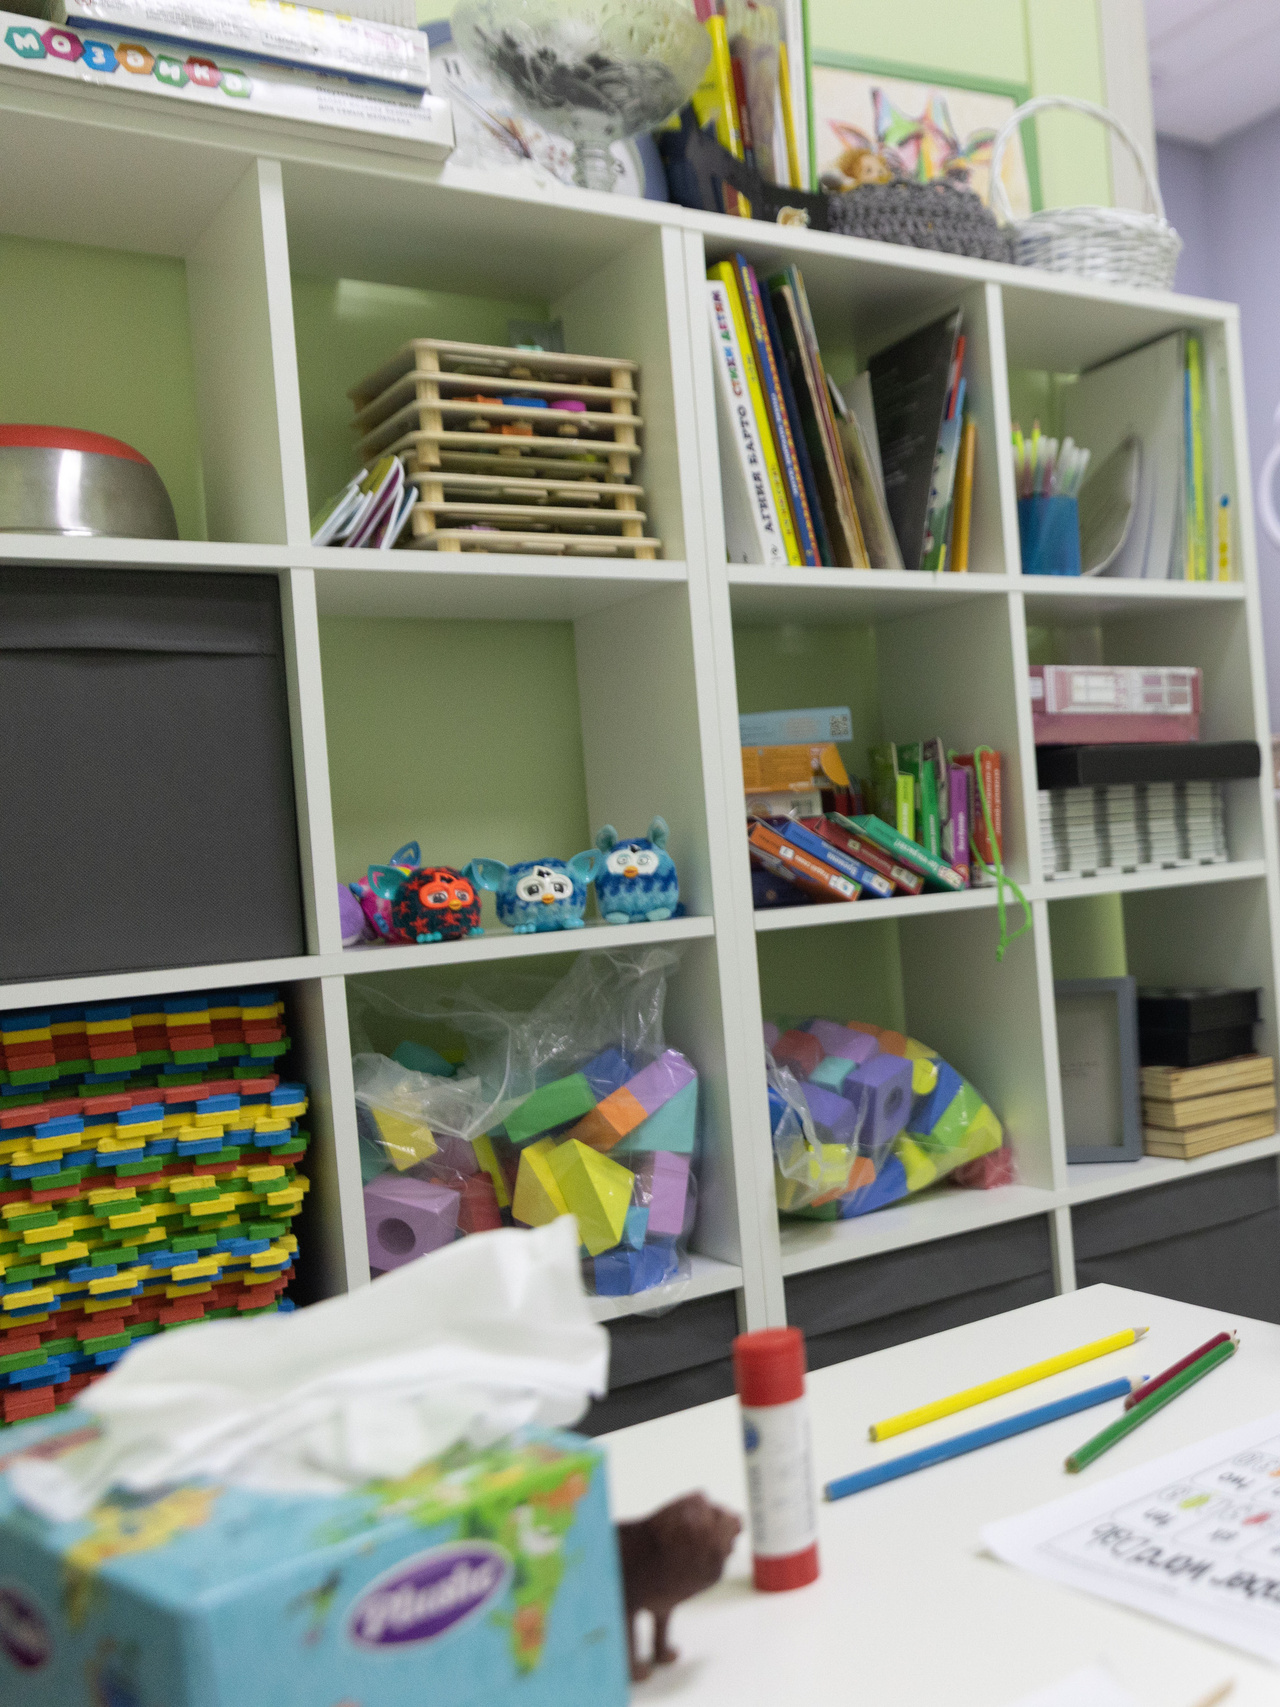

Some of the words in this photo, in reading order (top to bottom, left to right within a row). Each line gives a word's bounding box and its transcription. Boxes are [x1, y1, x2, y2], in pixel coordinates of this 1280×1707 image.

[711, 289, 732, 342] ДЕТЯМ
[723, 346, 743, 397] СТИХИ
[737, 403, 759, 464] БАРТО
[752, 472, 775, 533] АГНИЯ
